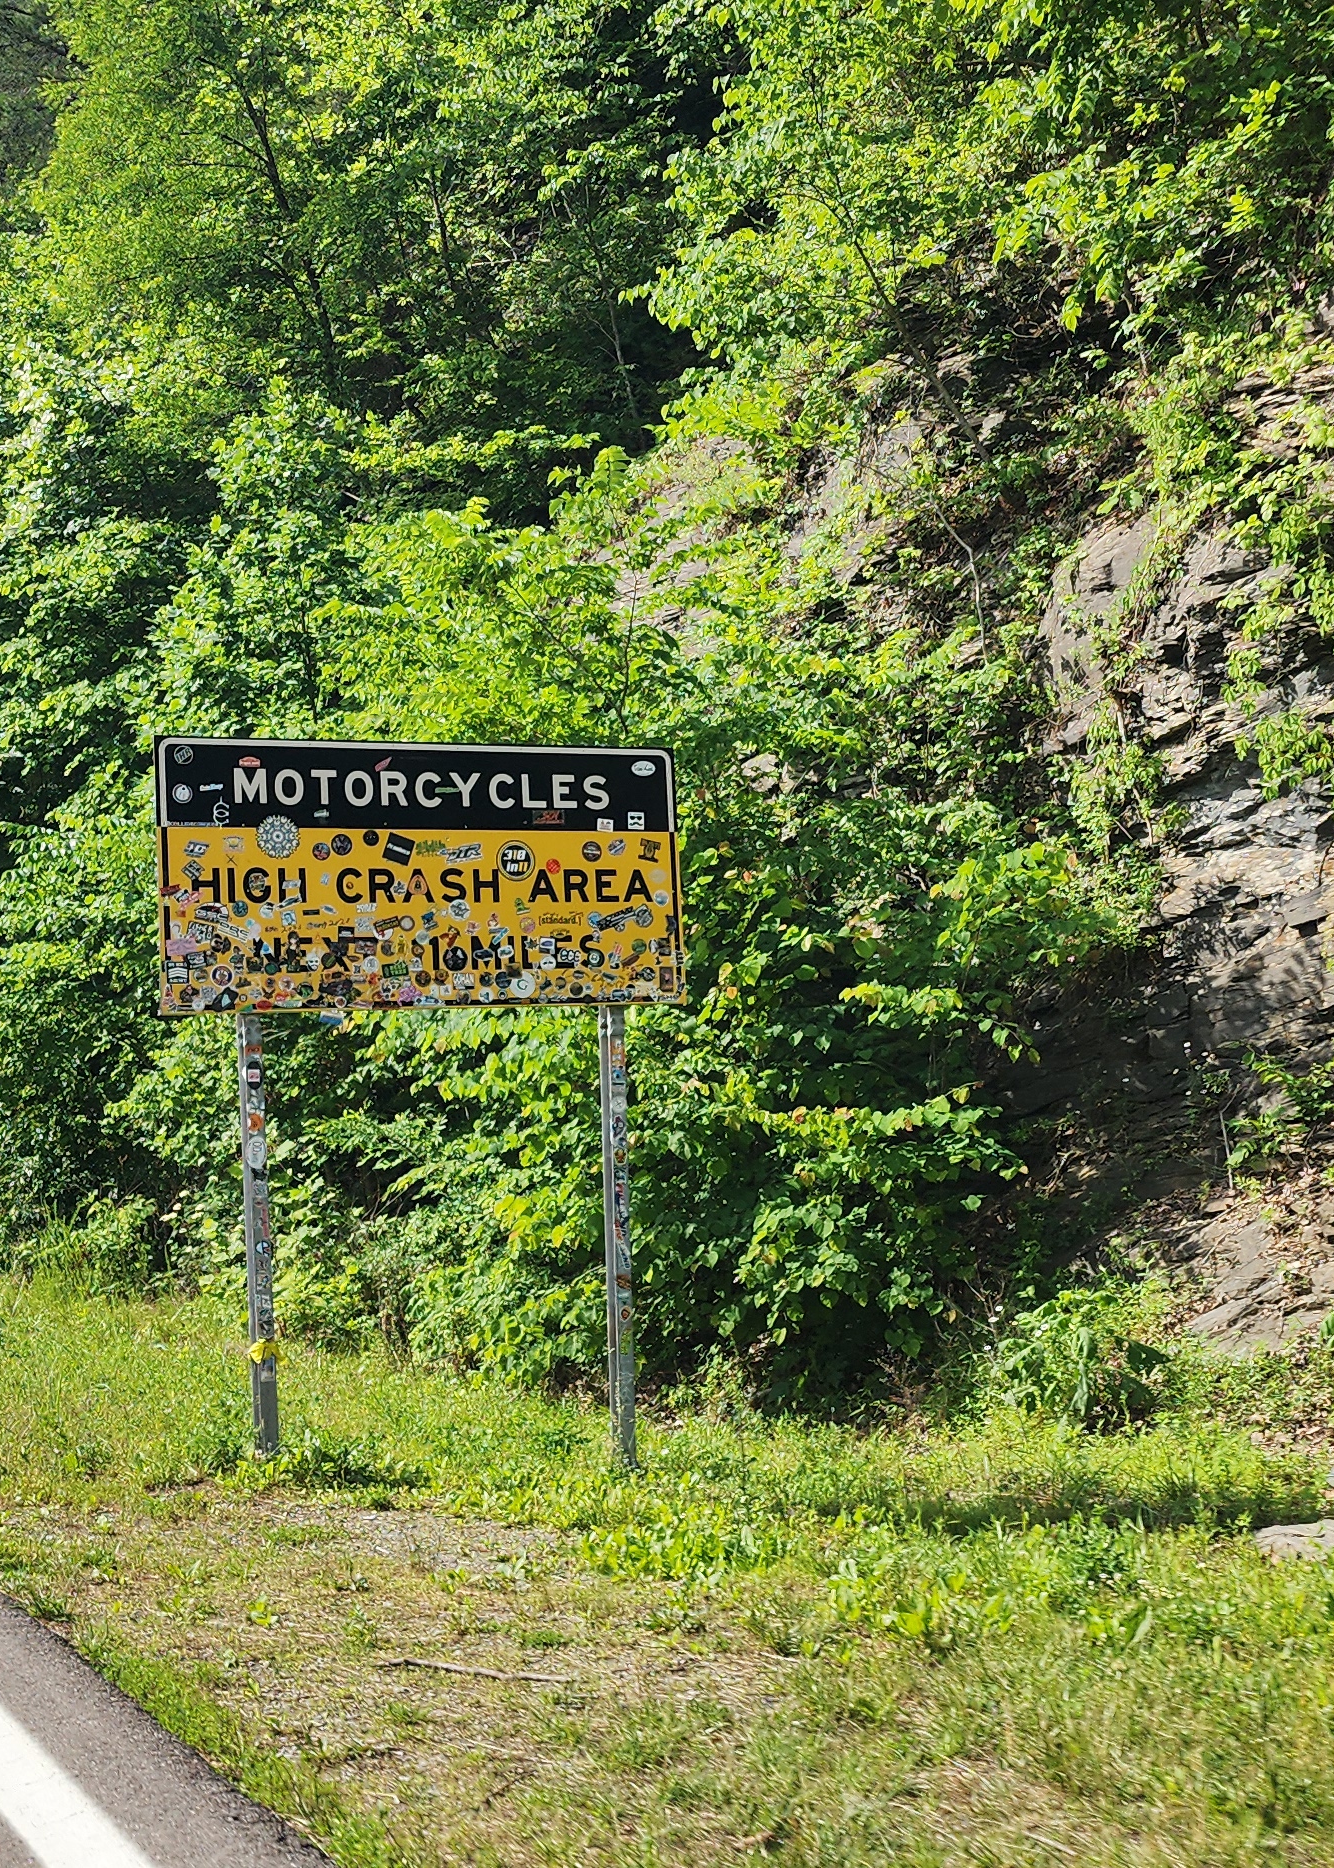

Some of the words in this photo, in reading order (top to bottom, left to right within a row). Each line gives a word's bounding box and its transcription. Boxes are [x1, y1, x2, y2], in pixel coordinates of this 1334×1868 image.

[233, 768, 610, 810] MOTORCYCLES
[191, 867, 307, 903] HIGH
[336, 867, 500, 904] CRASH
[528, 868, 654, 903] AREA
